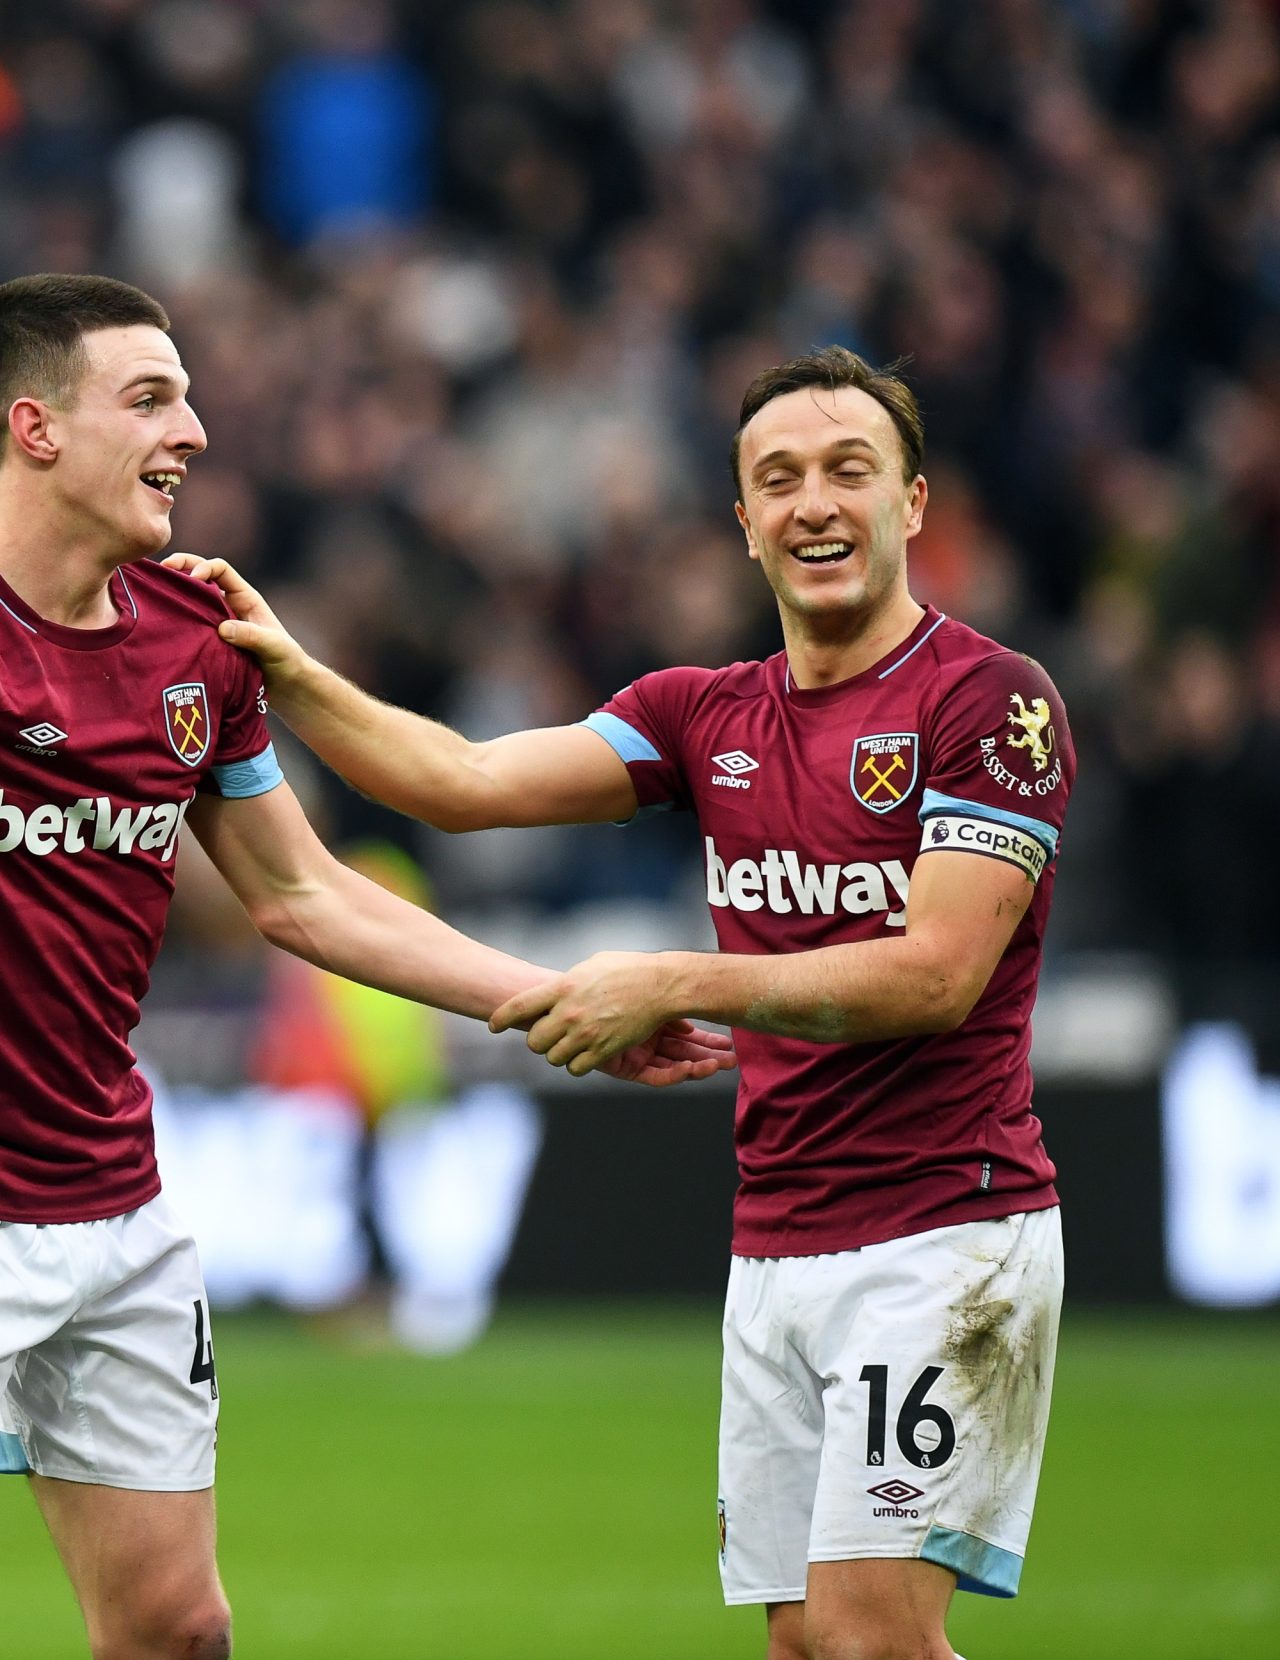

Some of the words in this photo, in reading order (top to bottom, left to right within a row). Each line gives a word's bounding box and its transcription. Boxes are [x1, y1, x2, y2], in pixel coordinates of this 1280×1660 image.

[167, 689, 184, 702] WEST
[184, 687, 201, 698] HAM
[861, 739, 887, 750] WEST
[888, 737, 912, 747] HAM
[870, 746, 900, 755] UNITED
[980, 736, 1019, 791] BASSET
[1018, 781, 1033, 797] &
[712, 775, 751, 789] umbro
[957, 823, 1043, 874] Captain
[705, 836, 911, 927] betway
[858, 1364, 957, 1469] 16
[873, 1505, 919, 1519] umbro
